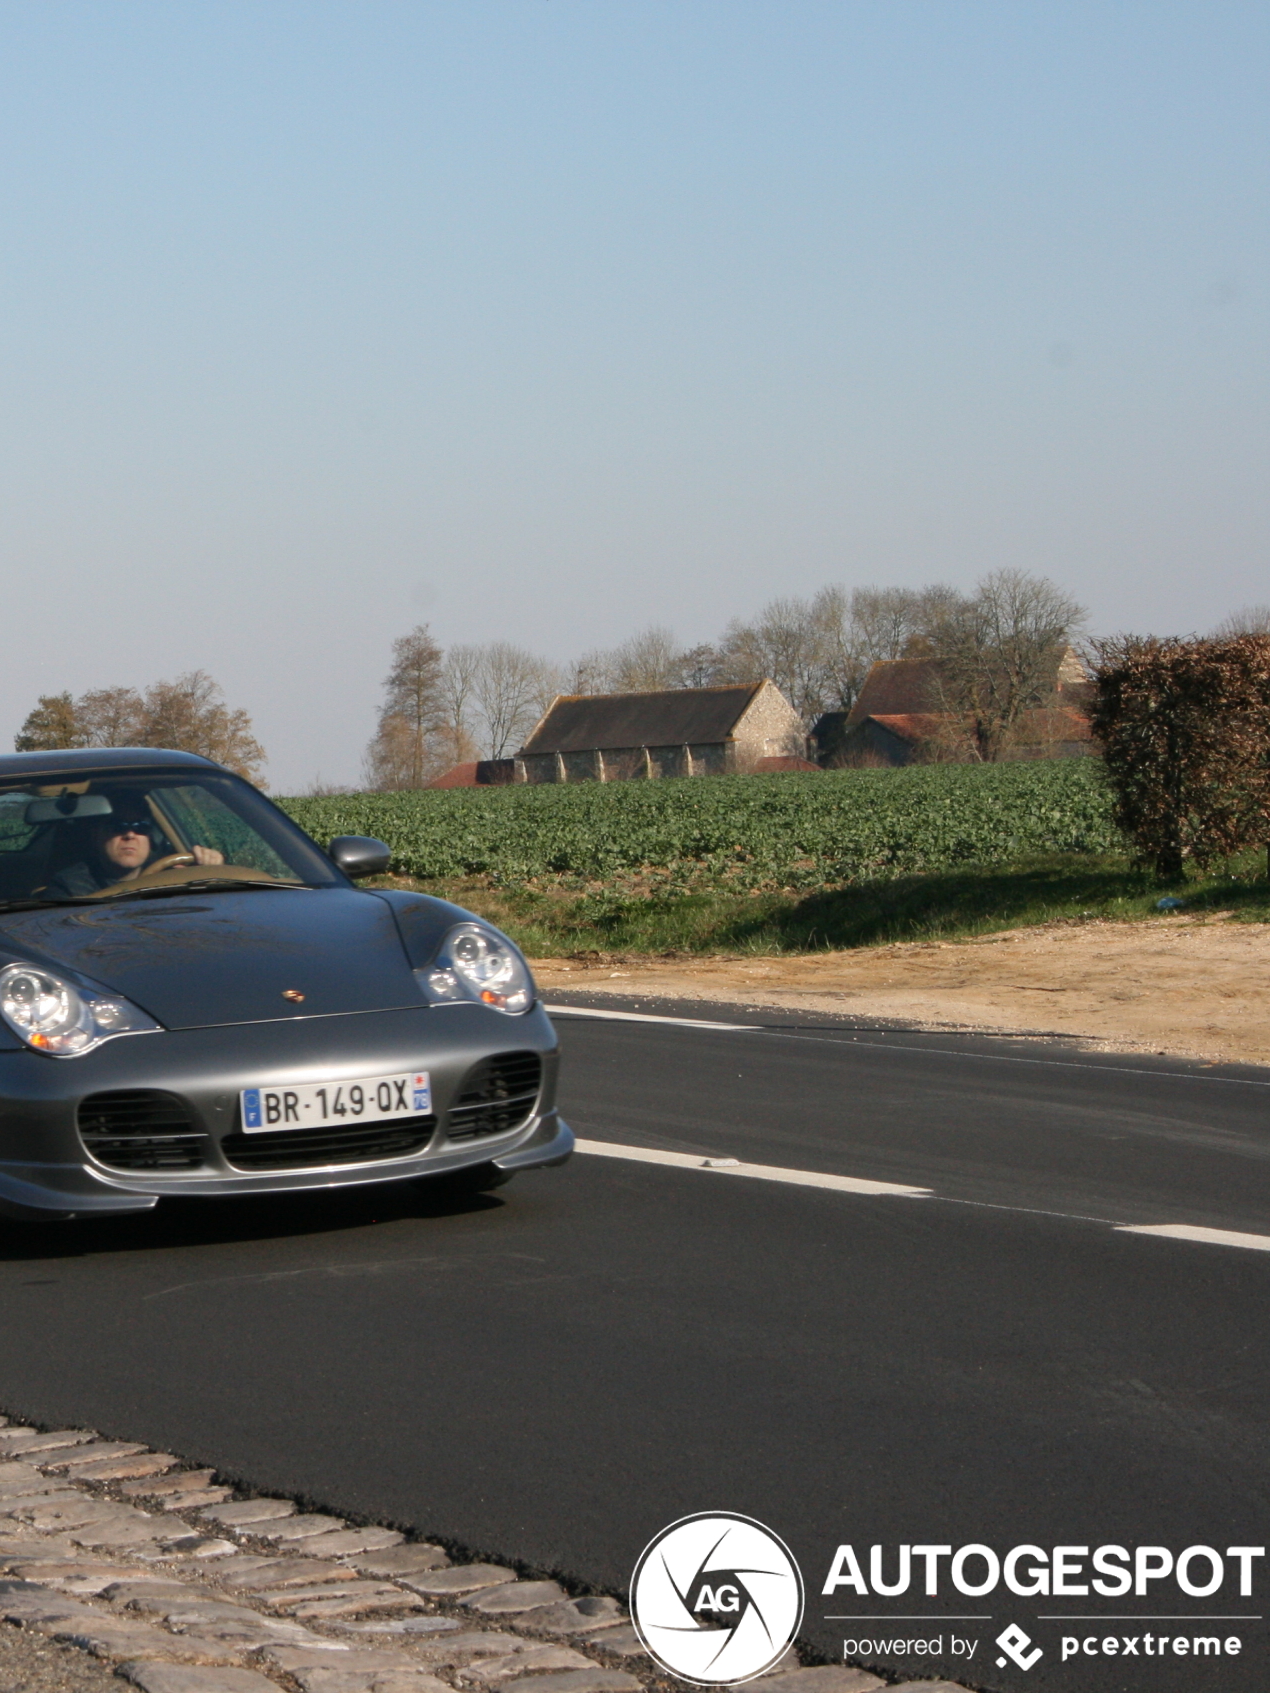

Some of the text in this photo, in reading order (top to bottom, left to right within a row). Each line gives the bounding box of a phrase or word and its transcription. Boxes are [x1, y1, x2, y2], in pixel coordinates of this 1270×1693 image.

[249, 1079, 429, 1124] F BR-149-QX 78
